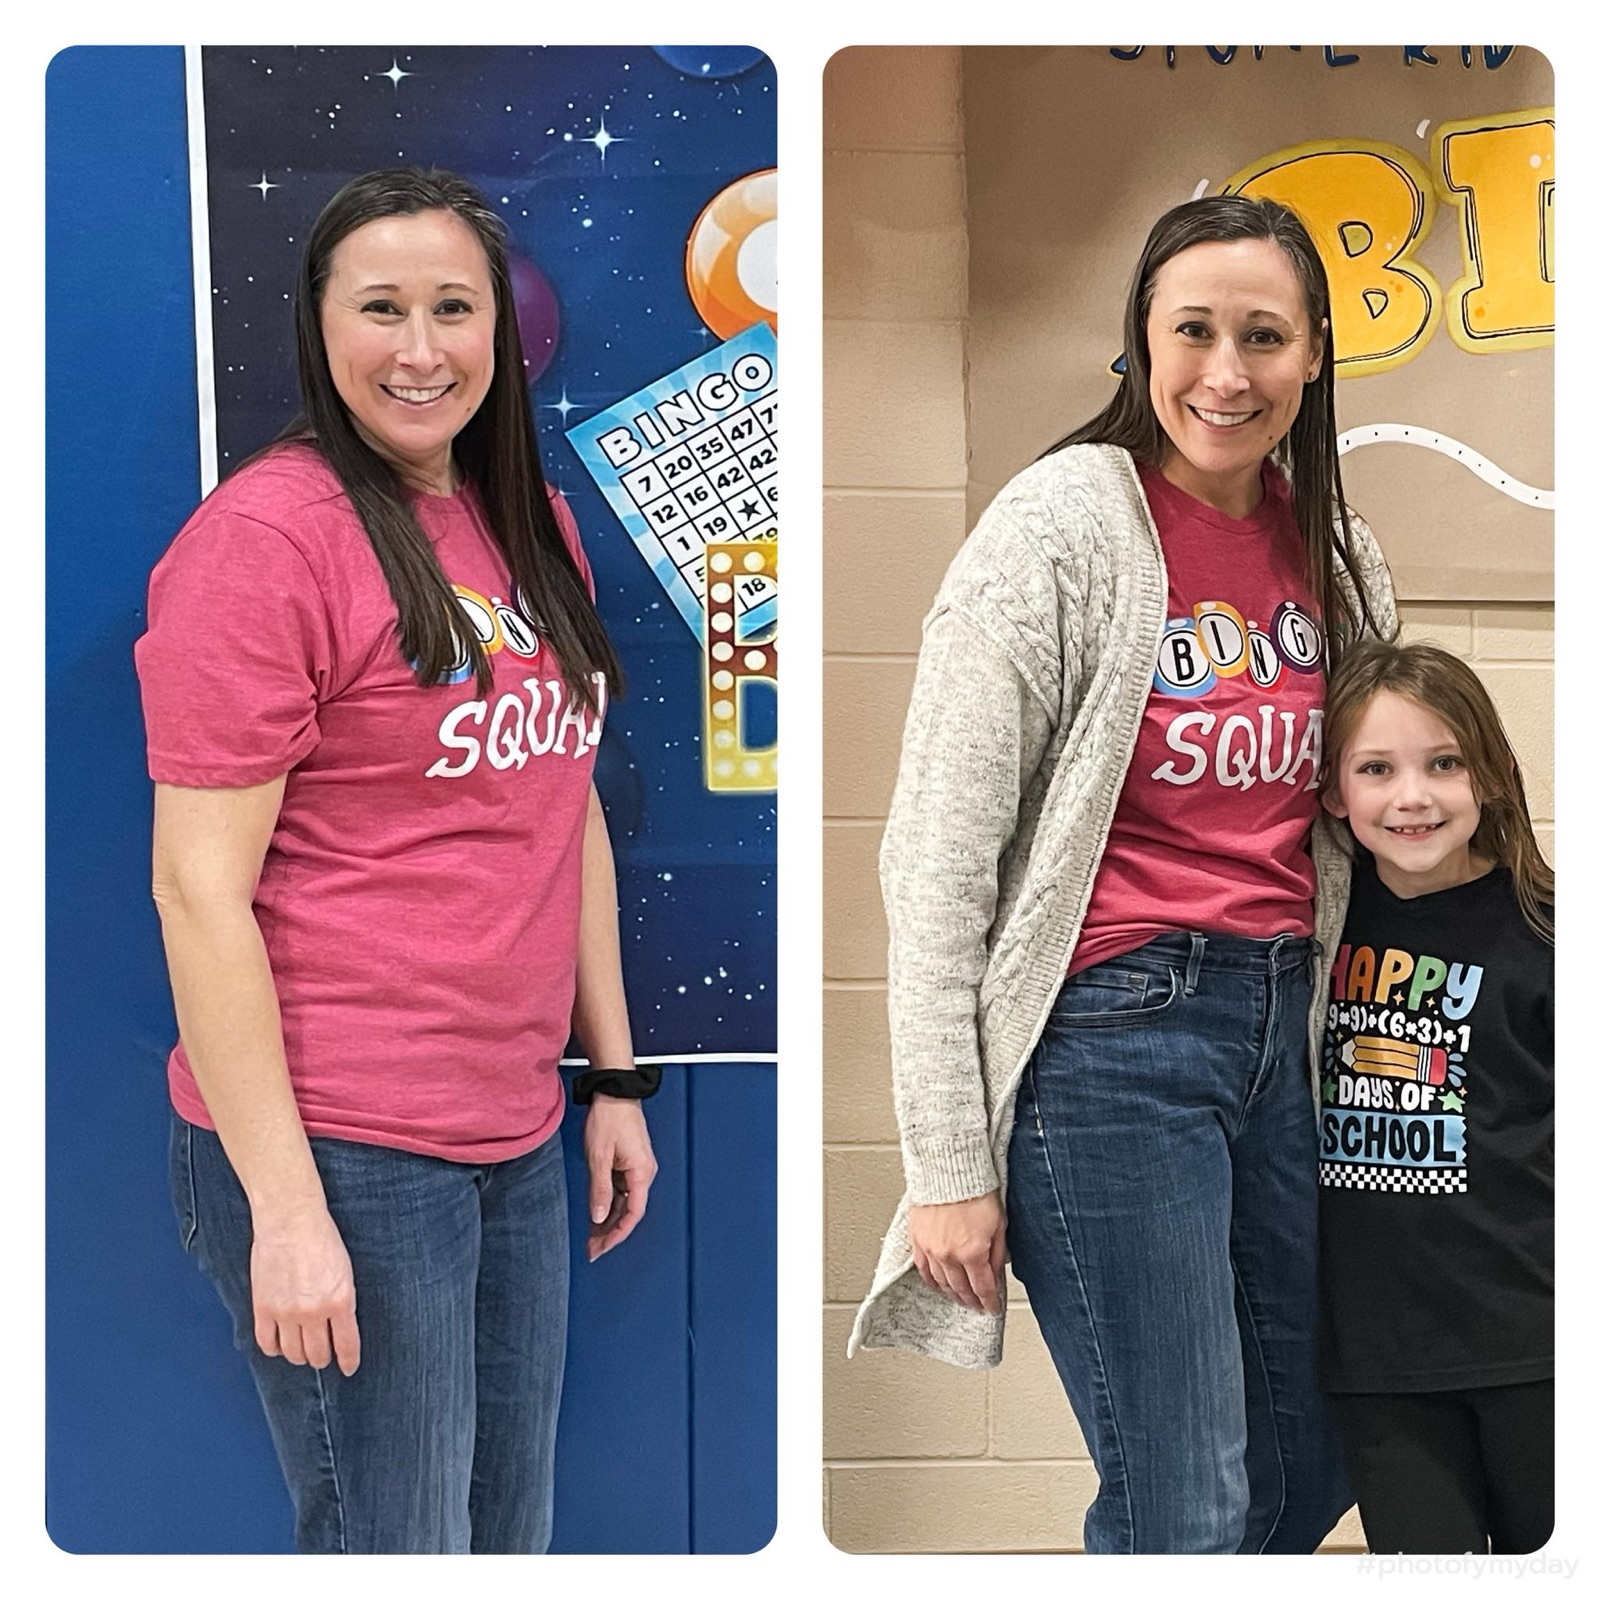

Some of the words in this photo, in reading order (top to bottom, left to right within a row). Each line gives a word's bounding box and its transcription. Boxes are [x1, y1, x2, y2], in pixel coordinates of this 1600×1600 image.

[596, 353, 773, 470] BINGO
[638, 476, 652, 493] 7
[664, 455, 692, 480] 20
[696, 437, 724, 461] 35
[731, 418, 753, 441] 47
[760, 403, 777, 424] 7
[652, 503, 678, 524] 12
[684, 487, 709, 506] 16
[716, 466, 745, 489] 42
[750, 448, 777, 470] 42
[677, 536, 691, 551] 1
[702, 516, 728, 537] 19
[741, 577, 766, 597] 18
[1166, 612, 1328, 688] BING
[1151, 704, 1325, 791] SQUA
[1338, 1075, 1395, 1110] DAYS
[1400, 1082, 1437, 1111] OF
[1323, 1113, 1457, 1163] SCHOOL
